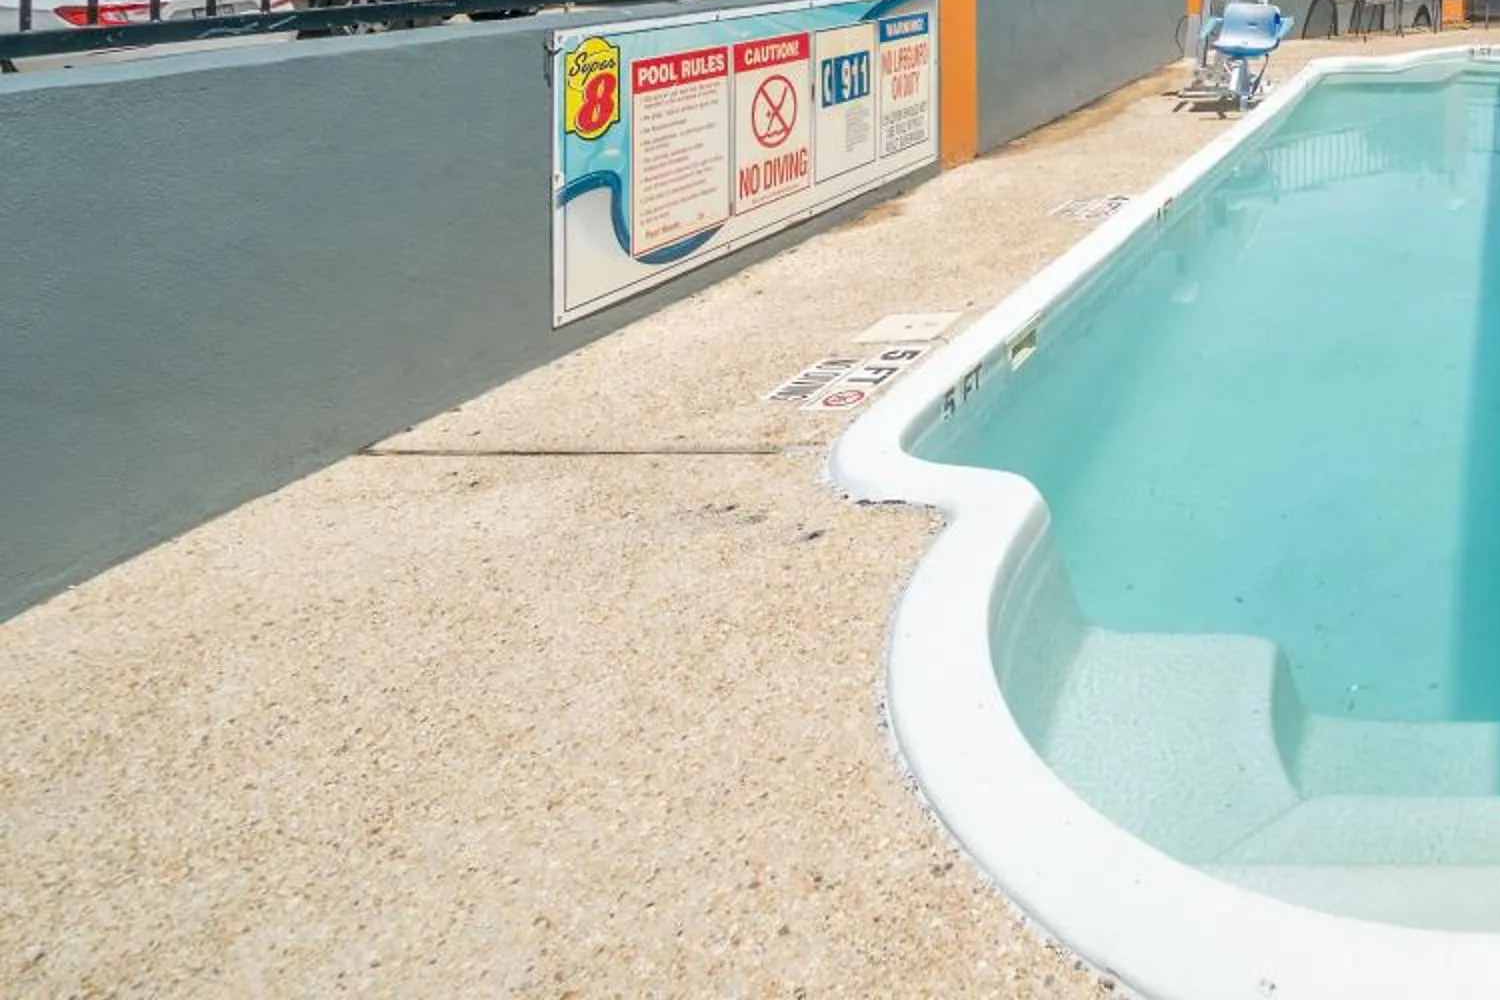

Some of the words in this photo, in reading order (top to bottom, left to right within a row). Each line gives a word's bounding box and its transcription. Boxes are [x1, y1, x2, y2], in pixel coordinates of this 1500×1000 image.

[569, 51, 616, 85] Super
[637, 62, 678, 87] POOL
[681, 53, 725, 79] RULES
[744, 40, 799, 66] CAUTION!
[842, 55, 867, 100] 911
[575, 73, 617, 133] 8
[739, 165, 761, 200] NO
[763, 148, 808, 190] DIVING
[880, 349, 921, 361] 5
[847, 366, 899, 385] FT
